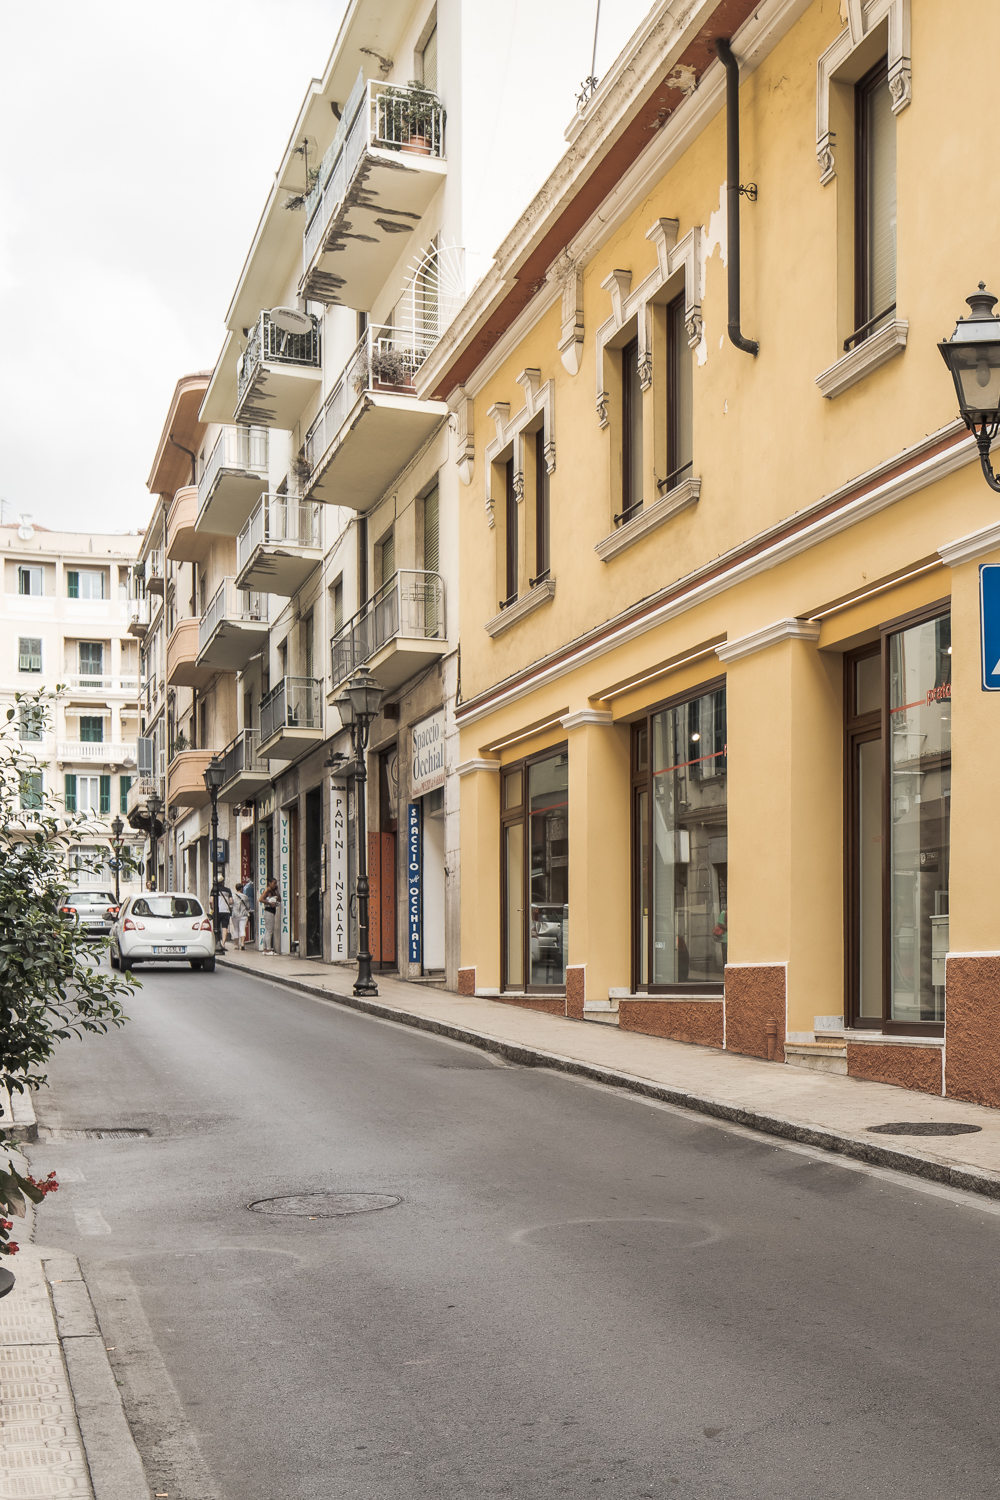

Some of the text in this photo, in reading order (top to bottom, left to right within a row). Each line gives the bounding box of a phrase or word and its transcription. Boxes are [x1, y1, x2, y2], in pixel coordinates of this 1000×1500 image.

[926, 681, 952, 707] prato
[412, 718, 440, 757] Spaccio
[409, 808, 419, 871] SPACCIO
[334, 799, 344, 953] PANINI INSALATE
[409, 887, 419, 959] OCCHIALI
